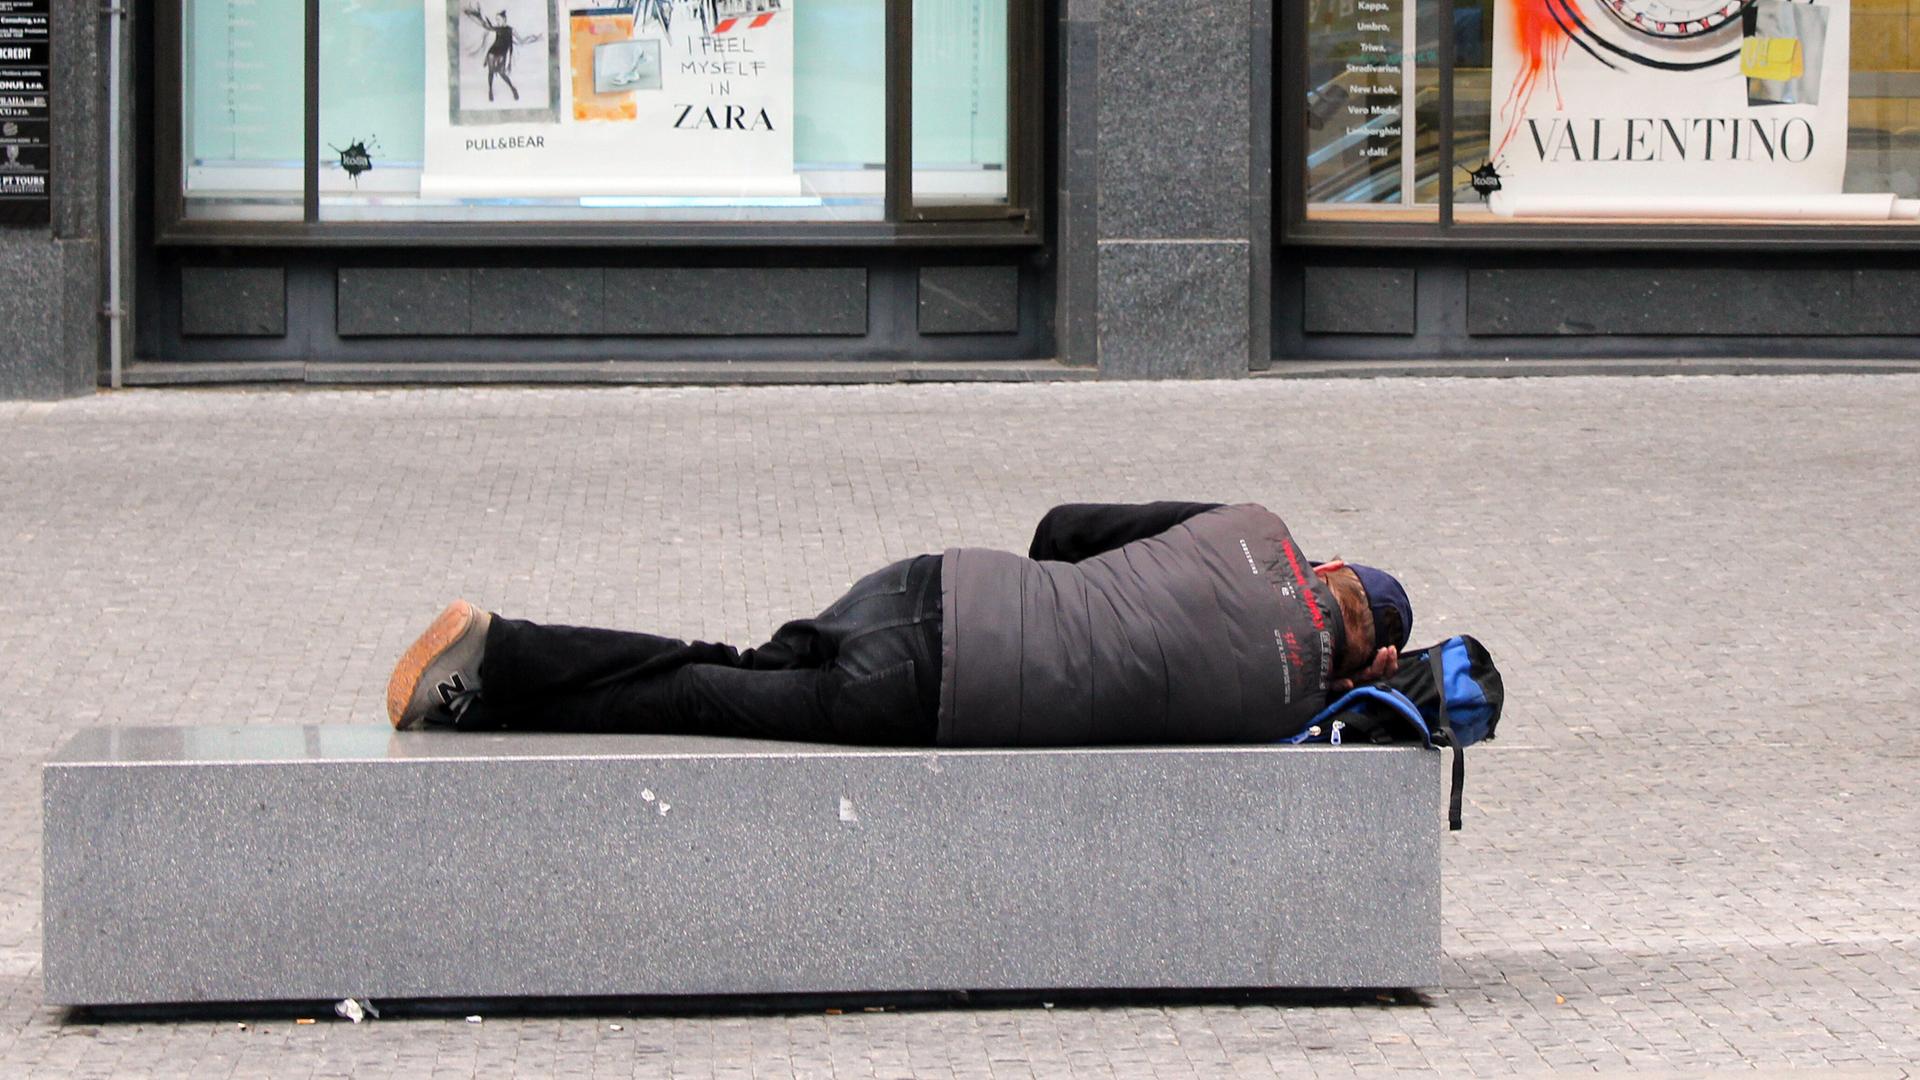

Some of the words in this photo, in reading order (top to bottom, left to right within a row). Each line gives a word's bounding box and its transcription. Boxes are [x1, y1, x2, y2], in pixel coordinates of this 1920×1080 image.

[1358, 1, 1389, 12] Kappa,
[1357, 22, 1390, 32] Umbro,
[700, 36, 754, 55] FEEL
[681, 61, 767, 77] MYSELF
[710, 80, 730, 96] IN
[1350, 85, 1371, 94] New
[1373, 85, 1397, 95] Look,
[1348, 105, 1369, 114] Vero
[673, 104, 775, 131] ZARA
[465, 136, 545, 151] PULL&BEAR
[1526, 117, 1815, 163] VALENTINO
